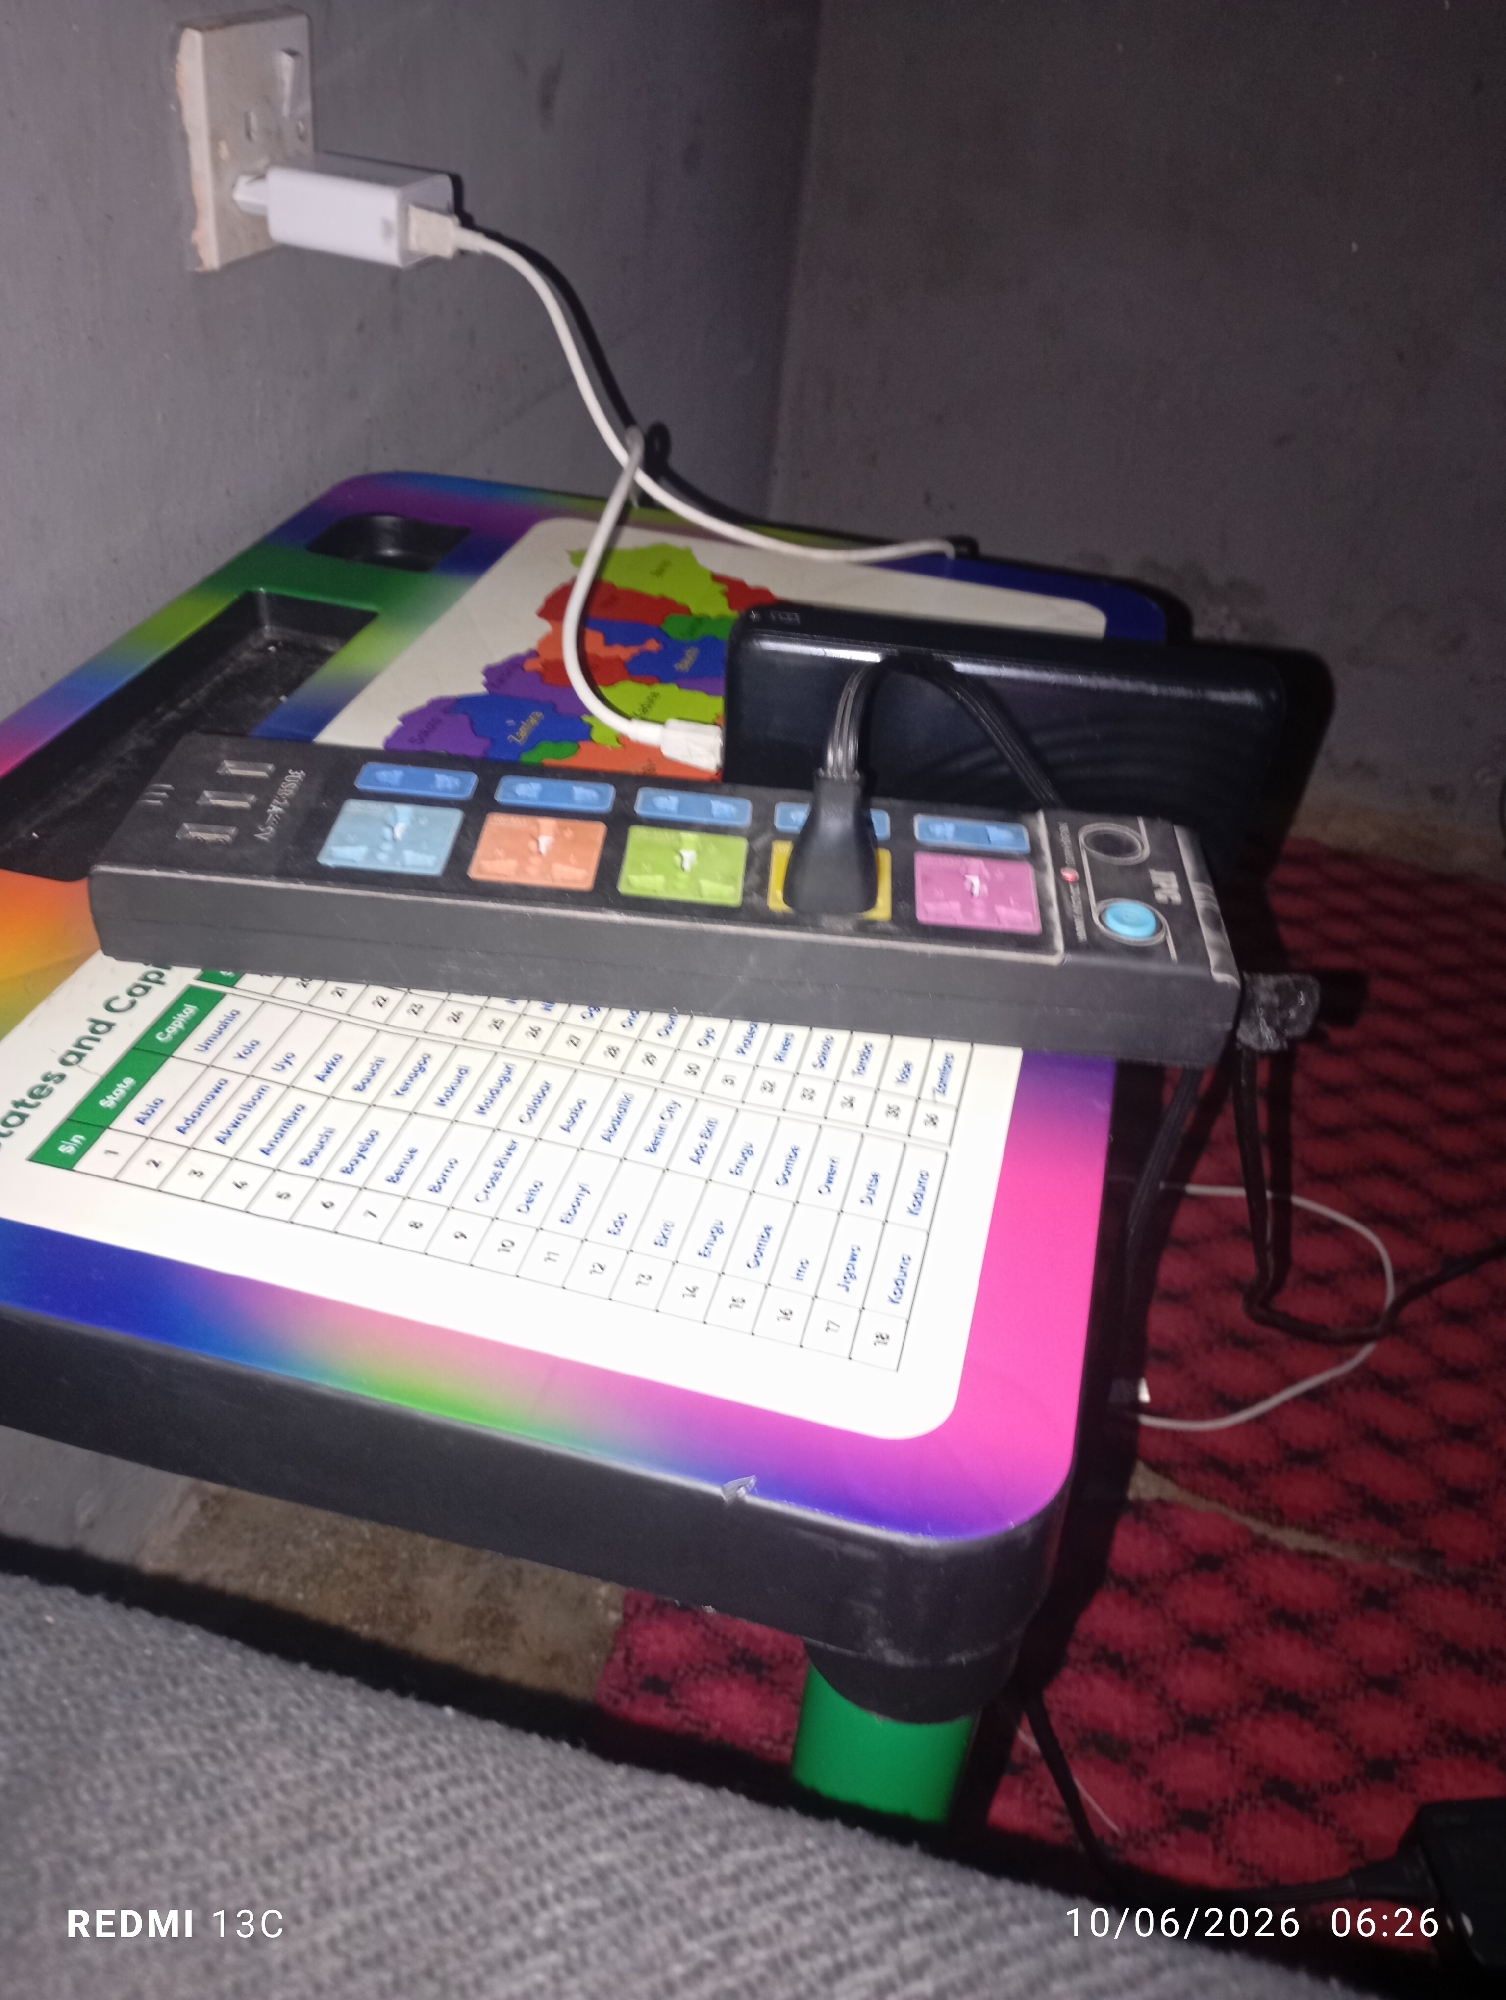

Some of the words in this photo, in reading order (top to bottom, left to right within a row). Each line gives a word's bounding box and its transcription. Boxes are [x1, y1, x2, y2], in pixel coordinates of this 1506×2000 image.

[57, 1017, 117, 1068] and
[331, 986, 348, 998] 21
[371, 995, 388, 1008] 22
[407, 1003, 423, 1016] 23
[448, 1010, 464, 1024] 24
[488, 1018, 504, 1031] 25
[526, 1025, 542, 1039] 26
[98, 1076, 137, 1110] State
[155, 1003, 200, 1044] Capital
[104, 1148, 119, 1158] 1
[134, 1097, 165, 1126] Abia
[194, 1007, 241, 1053] Umuahia
[147, 1159, 160, 1169] 2
[175, 1077, 229, 1135] Adamawa
[235, 1038, 260, 1061] Yola
[684, 1062, 700, 1078] 30
[697, 1027, 716, 1048] Oyo
[189, 1168, 204, 1179] 3
[214, 1113, 243, 1145] Akwa
[239, 1084, 270, 1118] Ibom
[271, 1051, 296, 1073] Uyo
[233, 1179, 248, 1190] 4
[259, 1103, 307, 1157] Anambra
[315, 1053, 343, 1083] Awka
[276, 1190, 291, 1200] 5
[300, 1127, 336, 1168] Bauchi
[353, 1056, 386, 1092] Bauchi
[321, 1200, 335, 1210] 6
[340, 1129, 380, 1176] Bayelsa
[391, 1052, 432, 1098] Yenagoa
[364, 1210, 379, 1220] 7
[385, 1146, 419, 1185] Benue
[434, 1064, 472, 1108] Makurdi
[454, 1230, 468, 1241] 9
[474, 1170, 503, 1204] Cross
[494, 1138, 520, 1175] River
[519, 1080, 553, 1125] Calabar
[409, 1219, 423, 1230] 8
[428, 1157, 459, 1195] Borno
[497, 1239, 516, 1254] 10
[516, 1179, 544, 1215] Delta
[558, 1097, 587, 1134] Asaba
[544, 1251, 560, 1263] 11
[560, 1182, 590, 1226] Ebonyi
[589, 1262, 606, 1276] 12
[607, 1211, 629, 1237] Edo
[644, 1122, 668, 1155] Benin
[659, 1099, 682, 1123] City
[635, 1273, 653, 1287] 13
[689, 1141, 708, 1166] Ado
[682, 1285, 699, 1299] 14
[697, 1218, 725, 1259] Enugu
[729, 1141, 755, 1177] Enugu
[728, 1296, 746, 1310] 15
[746, 1224, 774, 1271] Gombe
[775, 1144, 800, 1187] Gombe
[777, 1307, 793, 1322] 16
[825, 1320, 840, 1334] 17
[873, 1331, 890, 1347] 18
[887, 1253, 912, 1305] Kaduna
